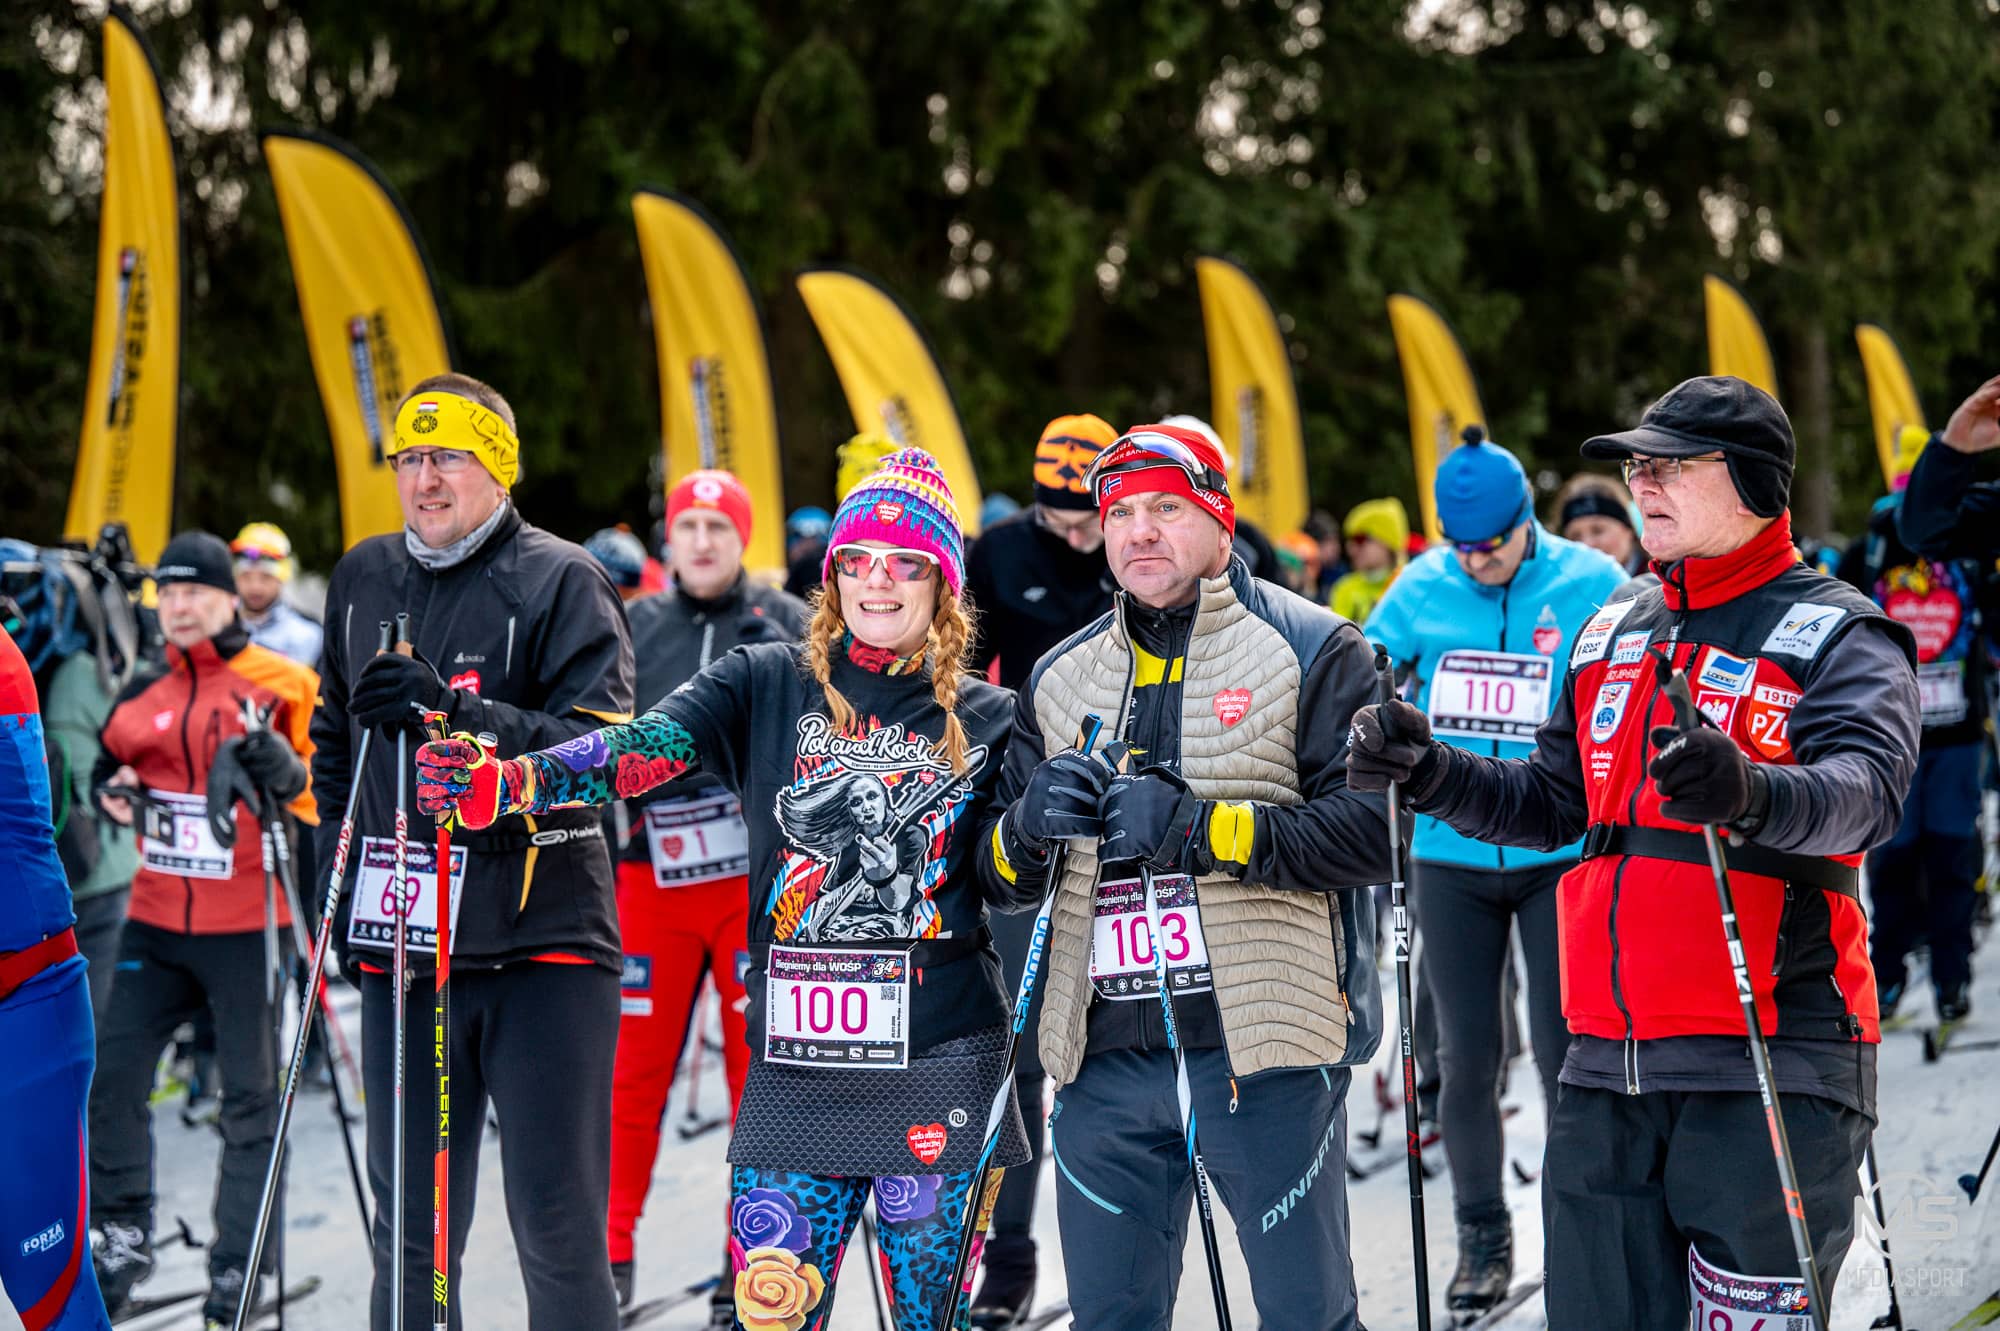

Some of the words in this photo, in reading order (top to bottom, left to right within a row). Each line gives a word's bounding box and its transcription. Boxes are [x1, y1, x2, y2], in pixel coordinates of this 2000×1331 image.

[1464, 680, 1515, 716] 110
[380, 875, 422, 919] 69
[1130, 891, 1144, 902] dla
[1154, 886, 1177, 899] OŚP
[1111, 912, 1191, 967] 103
[1391, 881, 1409, 962] LEKI
[775, 959, 812, 973] Biegniemy
[812, 960, 827, 971] dla
[829, 961, 862, 972] WOŚP
[873, 959, 897, 977] 34
[1721, 913, 1753, 1004] LEKI
[790, 985, 868, 1035] 100
[435, 1007, 444, 1068] LEKI
[440, 1075, 449, 1137] LEKI
[1713, 1284, 1728, 1296] dla
[1729, 1286, 1767, 1302] WOŚP
